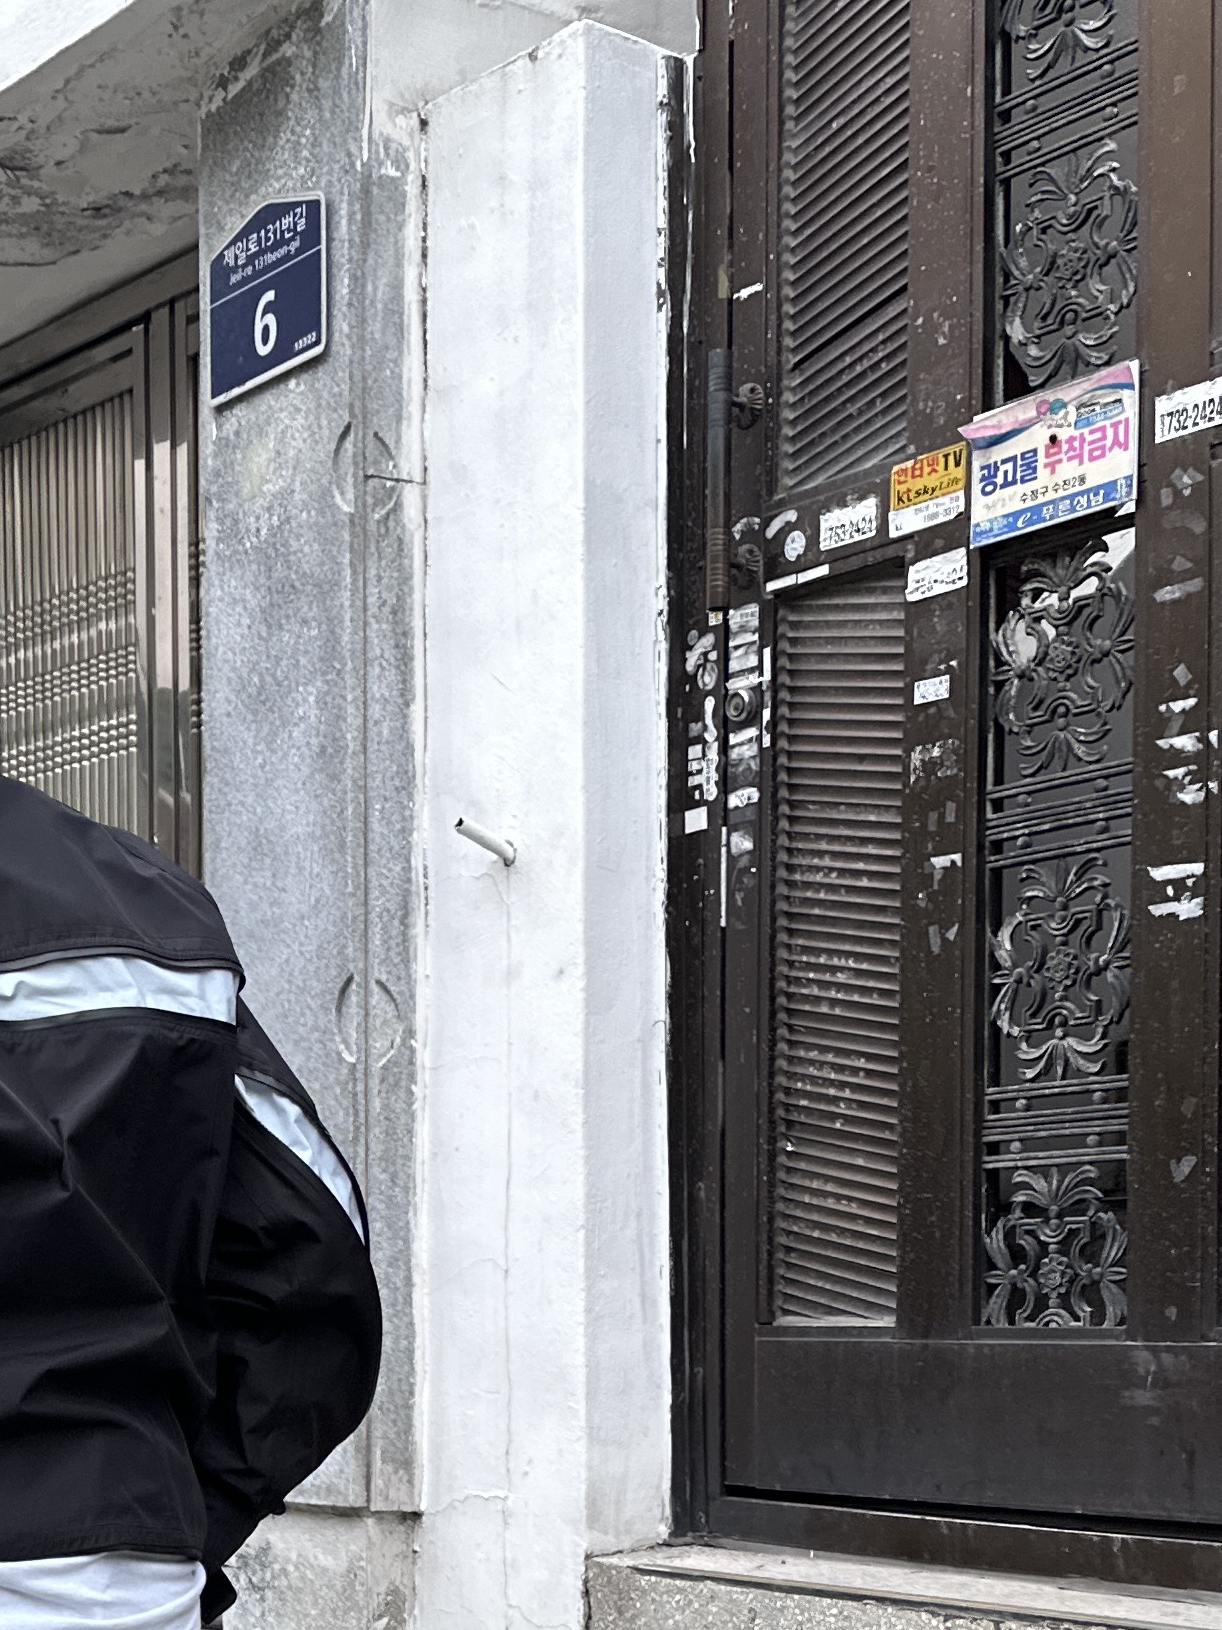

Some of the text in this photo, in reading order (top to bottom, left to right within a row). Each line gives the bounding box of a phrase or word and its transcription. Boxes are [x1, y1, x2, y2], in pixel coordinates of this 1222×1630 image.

[223, 203, 306, 268] 제일로131번길
[230, 234, 301, 286] Jeil-ro 131beon-gil
[253, 289, 279, 357] 6
[979, 447, 1039, 496] 광고물
[1043, 416, 1130, 476] 부착금지
[1020, 486, 1049, 504] 수정구
[1052, 473, 1087, 495] 수진2동
